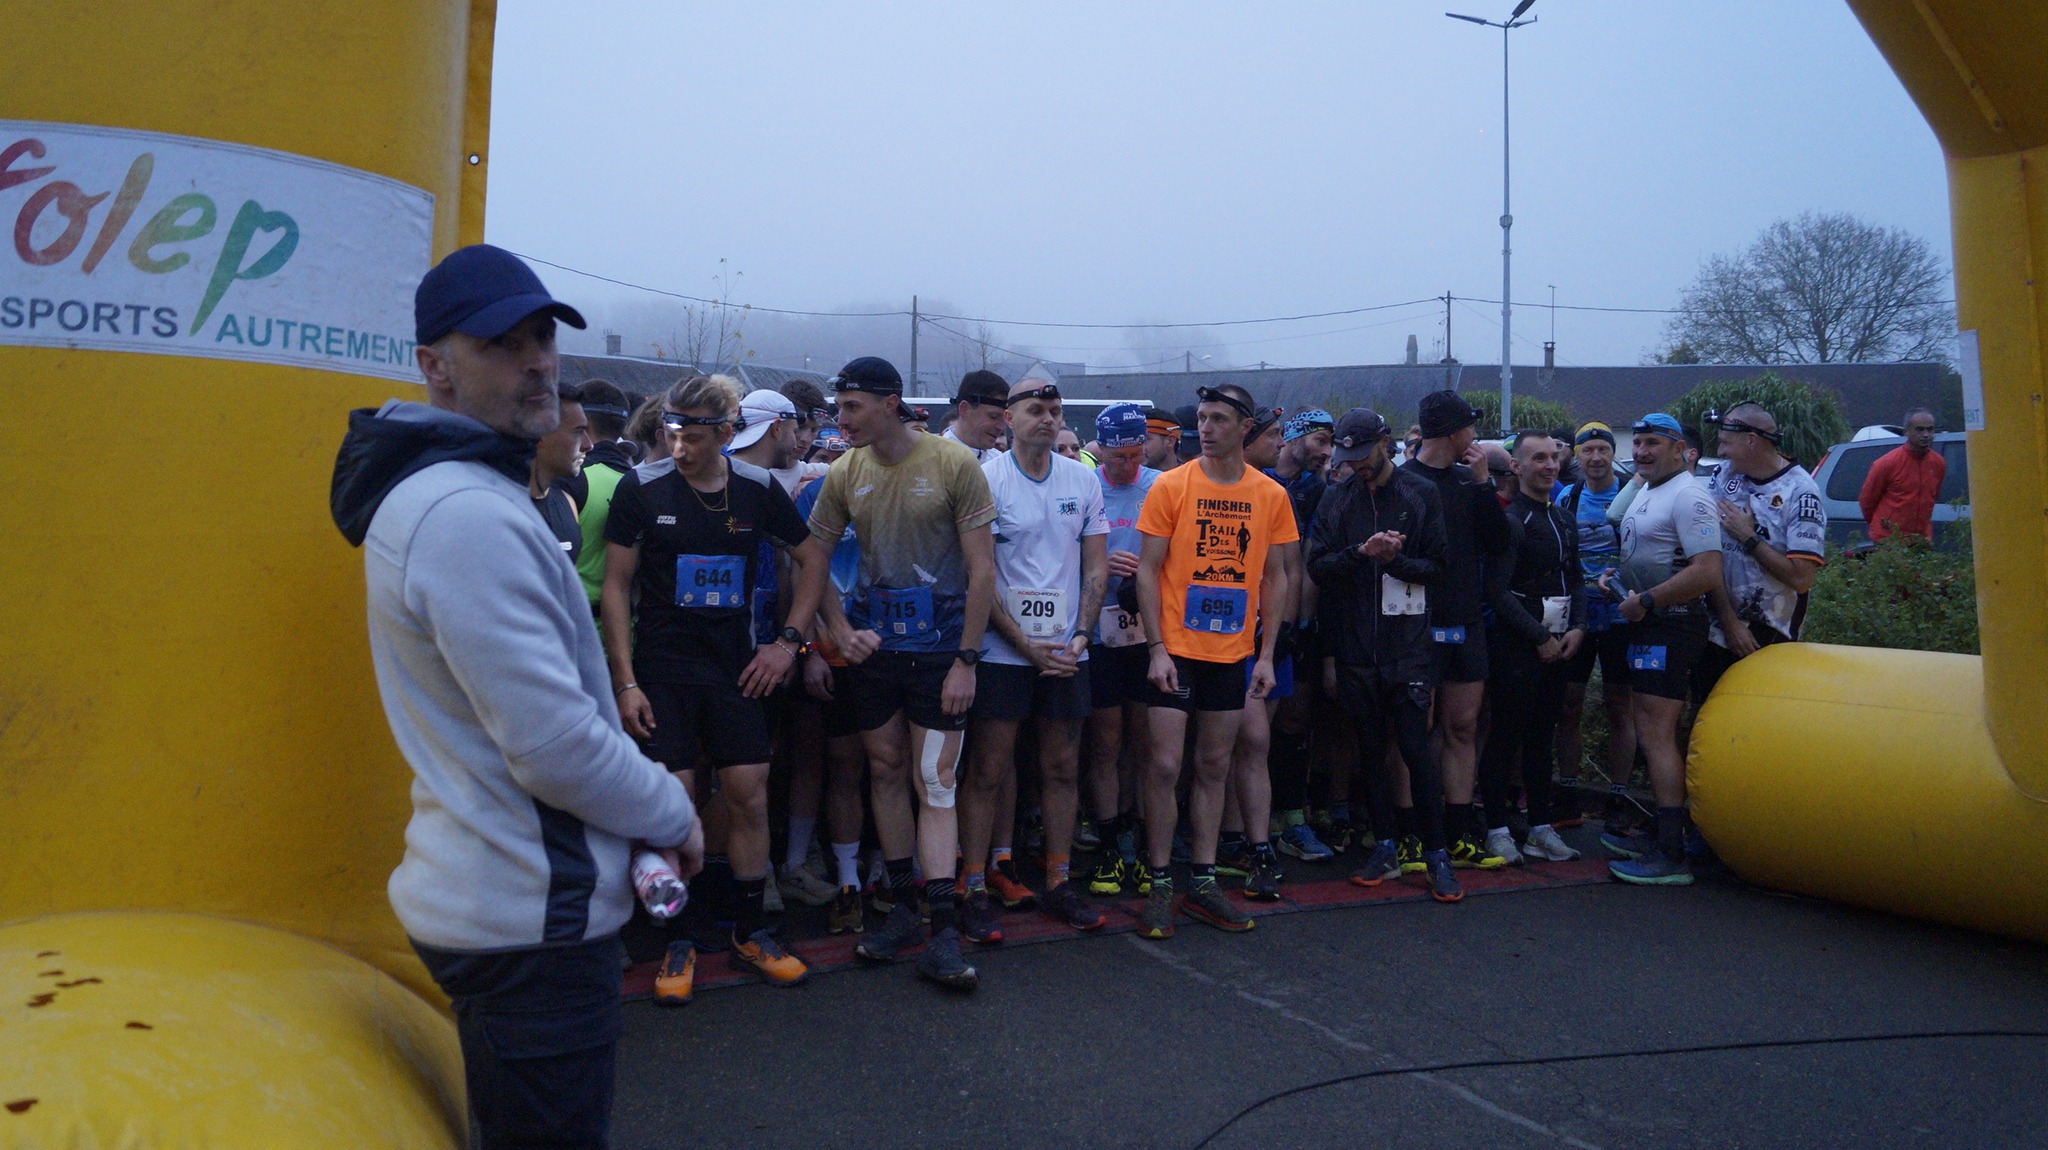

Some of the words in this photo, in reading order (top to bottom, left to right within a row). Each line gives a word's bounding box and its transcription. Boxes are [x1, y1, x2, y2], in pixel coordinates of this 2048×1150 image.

[0, 296, 178, 338] SPORTS
[215, 313, 417, 367] AUTREMENT
[1197, 499, 1252, 513] FINISHER
[1117, 519, 1132, 529] By
[1197, 510, 1252, 521] L'Archemont
[1196, 520, 1236, 540] TRAIL
[695, 568, 732, 587] 644
[881, 600, 916, 618] 715
[1021, 600, 1055, 618] 209
[1201, 598, 1234, 617] 695
[1118, 614, 1138, 630] 84
